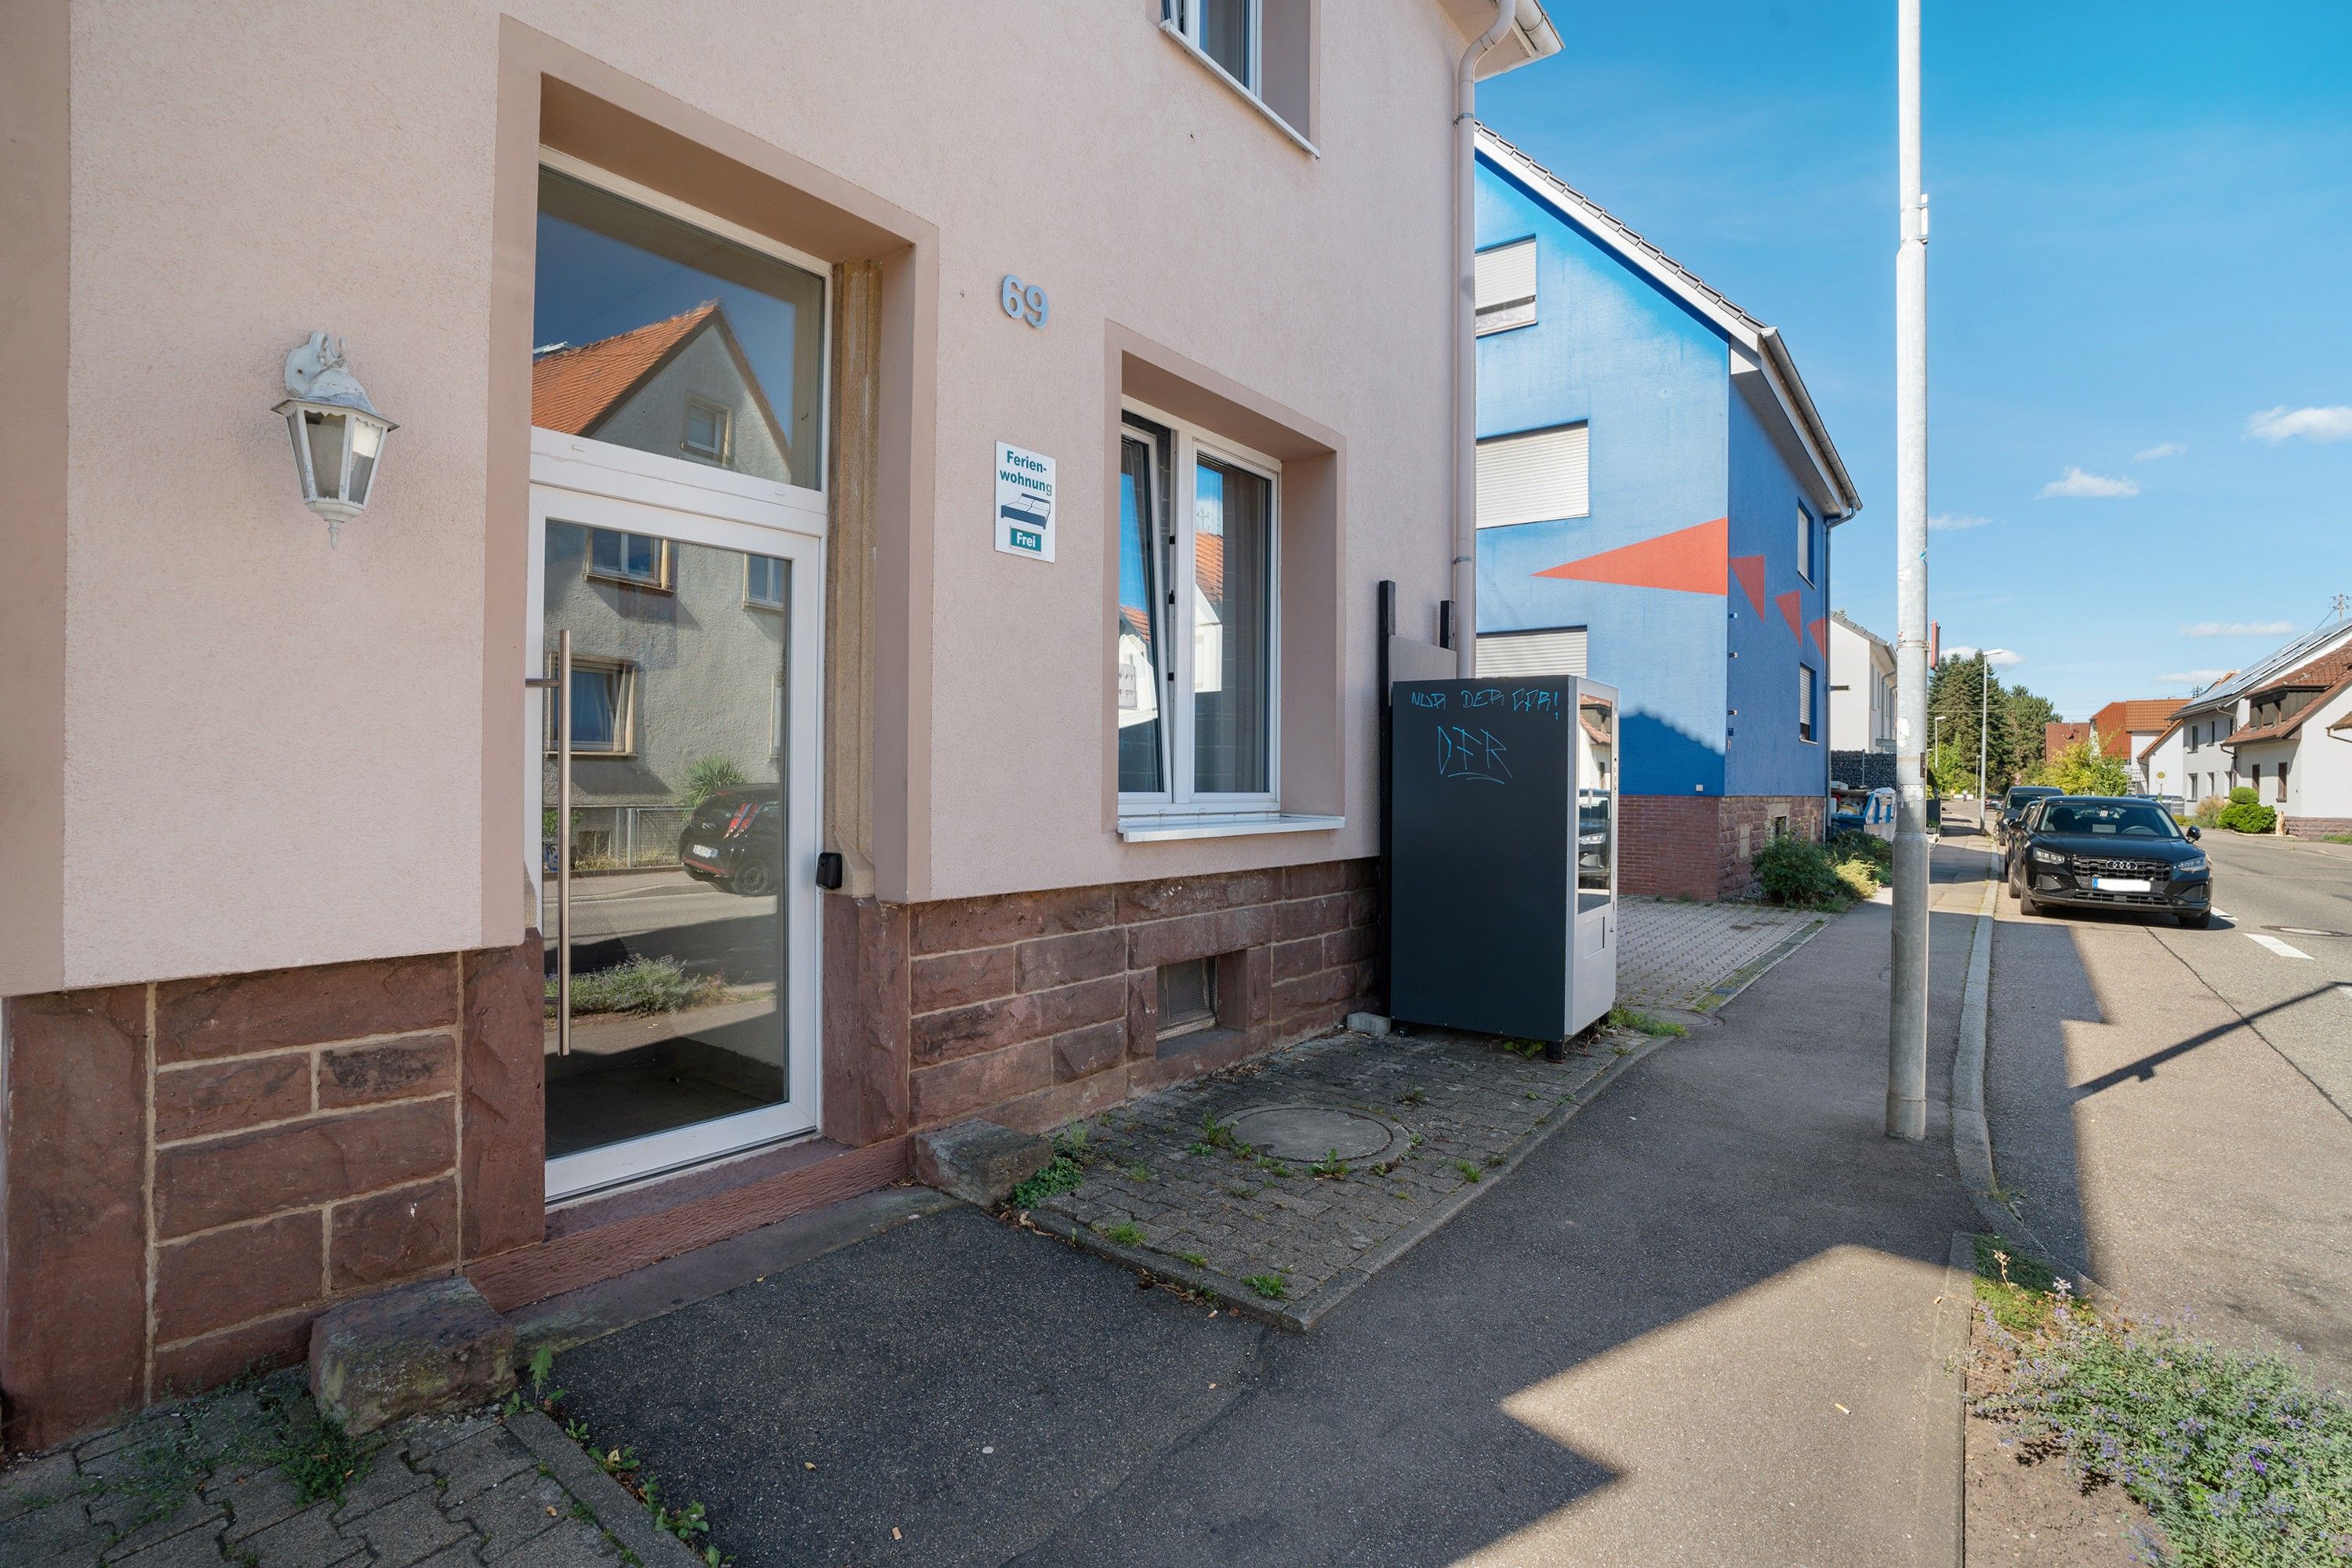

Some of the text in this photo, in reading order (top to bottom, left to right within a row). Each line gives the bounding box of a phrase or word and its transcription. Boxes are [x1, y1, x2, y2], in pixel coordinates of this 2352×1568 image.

[1001, 274, 1050, 329] 69
[1007, 449, 1047, 474] Ferien-
[1000, 469, 1053, 496] wohnung
[1016, 531, 1036, 548] Frei
